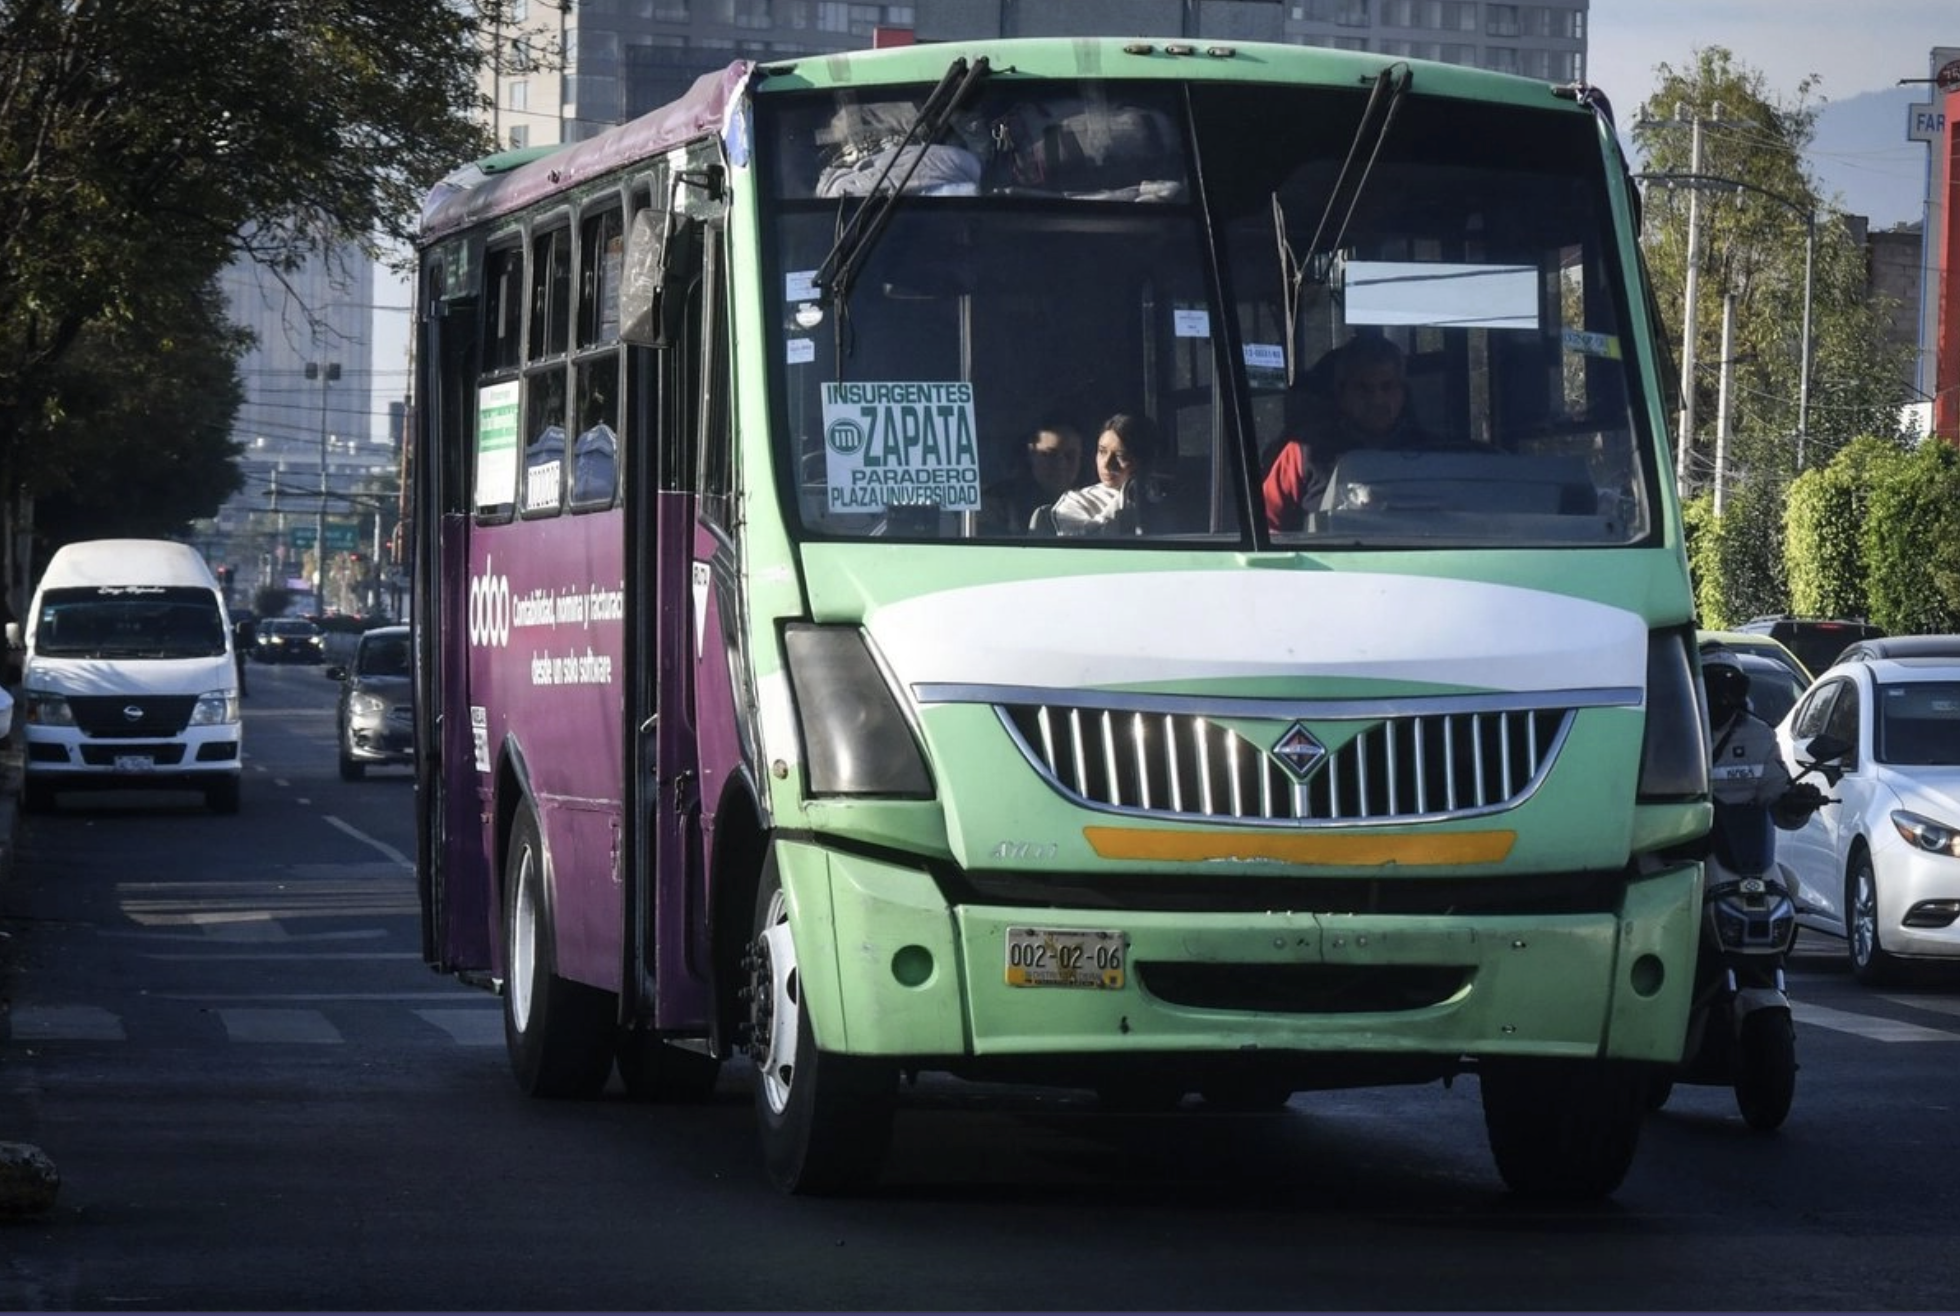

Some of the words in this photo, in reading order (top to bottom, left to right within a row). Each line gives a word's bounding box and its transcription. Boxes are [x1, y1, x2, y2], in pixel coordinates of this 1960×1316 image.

[827, 383, 971, 404] INSURGENTES
[860, 405, 976, 467] ZAPATA
[852, 468, 977, 485] PARADERO
[831, 487, 879, 507] PLAZA
[880, 485, 978, 507] UNIVERSIDAD
[469, 553, 510, 648] odoo
[513, 588, 556, 630] Contabilidad,
[556, 584, 583, 622] nómina
[531, 649, 552, 685] desde
[552, 658, 563, 684] un
[563, 647, 578, 684] solo
[579, 645, 612, 684] software
[1010, 942, 1120, 970] 002-02-06
